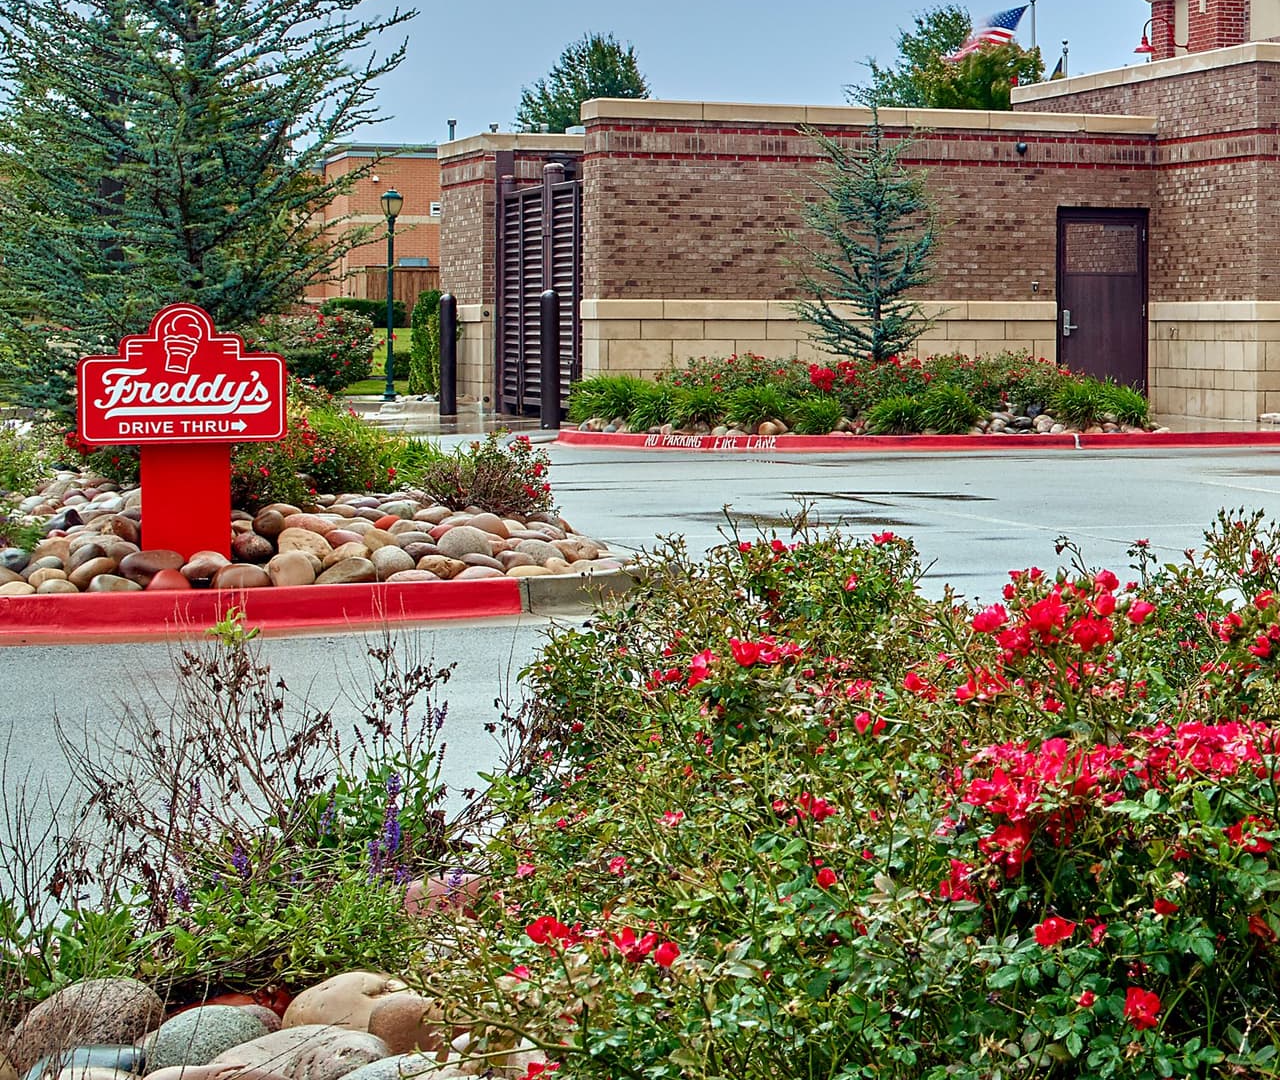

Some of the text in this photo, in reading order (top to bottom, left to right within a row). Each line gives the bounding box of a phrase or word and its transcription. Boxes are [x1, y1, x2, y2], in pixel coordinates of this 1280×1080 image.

[94, 368, 272, 420] Freddy's
[118, 420, 230, 434] DRIVE THRU
[645, 434, 659, 447] NO
[662, 434, 703, 448] PARKING
[746, 436, 776, 449] LANE
